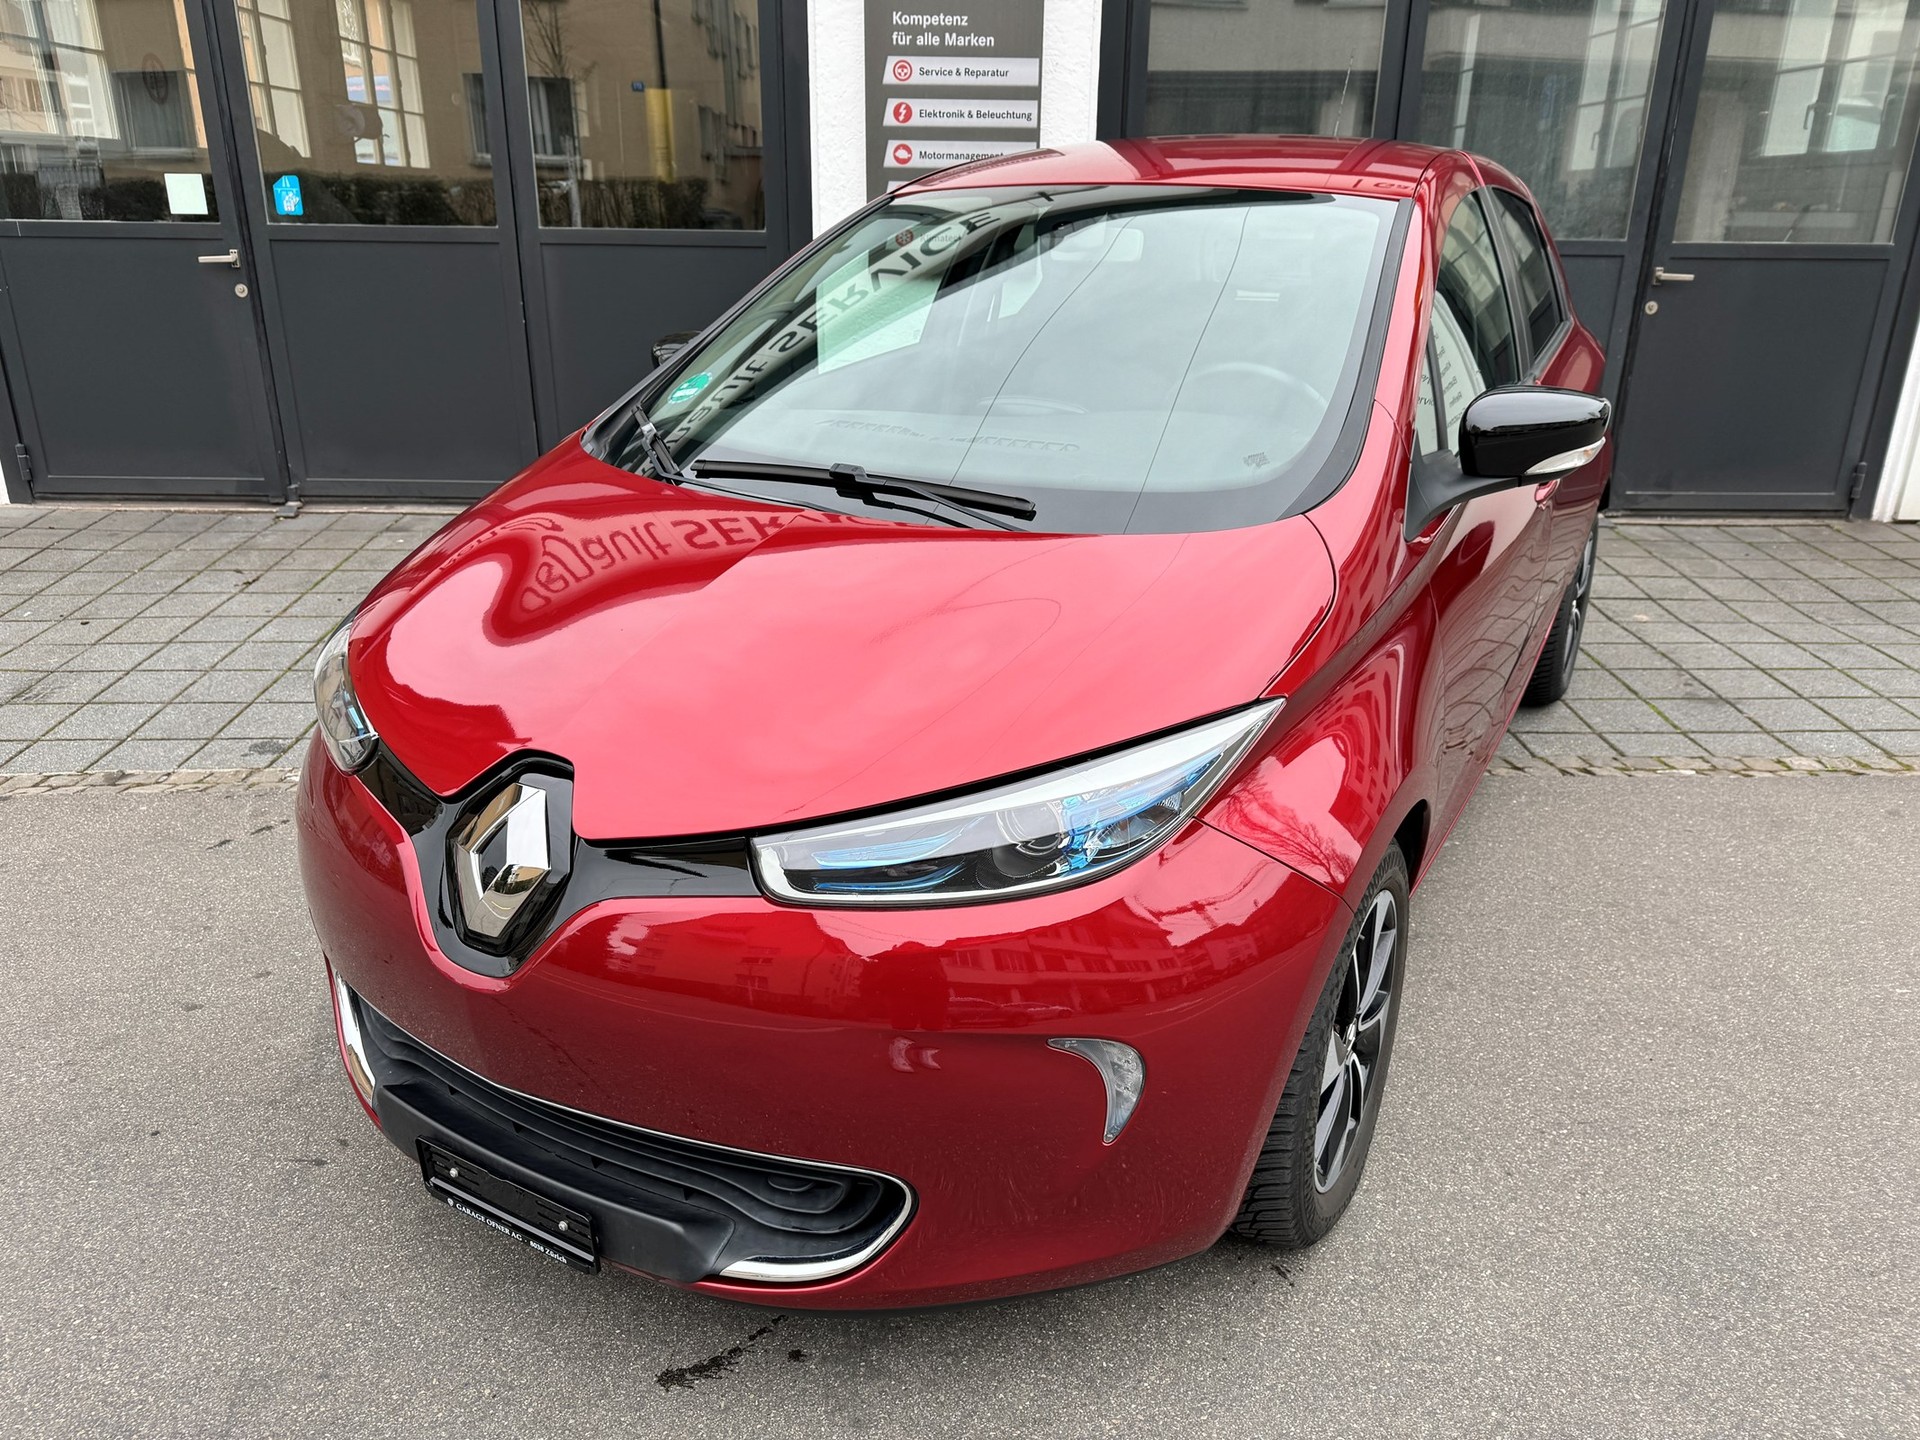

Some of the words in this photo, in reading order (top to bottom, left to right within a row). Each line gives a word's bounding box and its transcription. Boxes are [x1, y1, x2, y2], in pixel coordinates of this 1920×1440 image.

[892, 11, 969, 29] Kompetenz
[892, 31, 912, 46] für
[916, 32, 941, 46] alle
[944, 33, 995, 47] Marken
[918, 67, 953, 77] Service
[955, 67, 962, 77] &
[964, 68, 1010, 79] Reparatur
[919, 109, 965, 119] Elektronik
[967, 110, 974, 119] &
[976, 110, 1033, 122] Beleuchtung
[456, 1203, 486, 1223] GARAGE
[511, 1231, 523, 1242] AG
